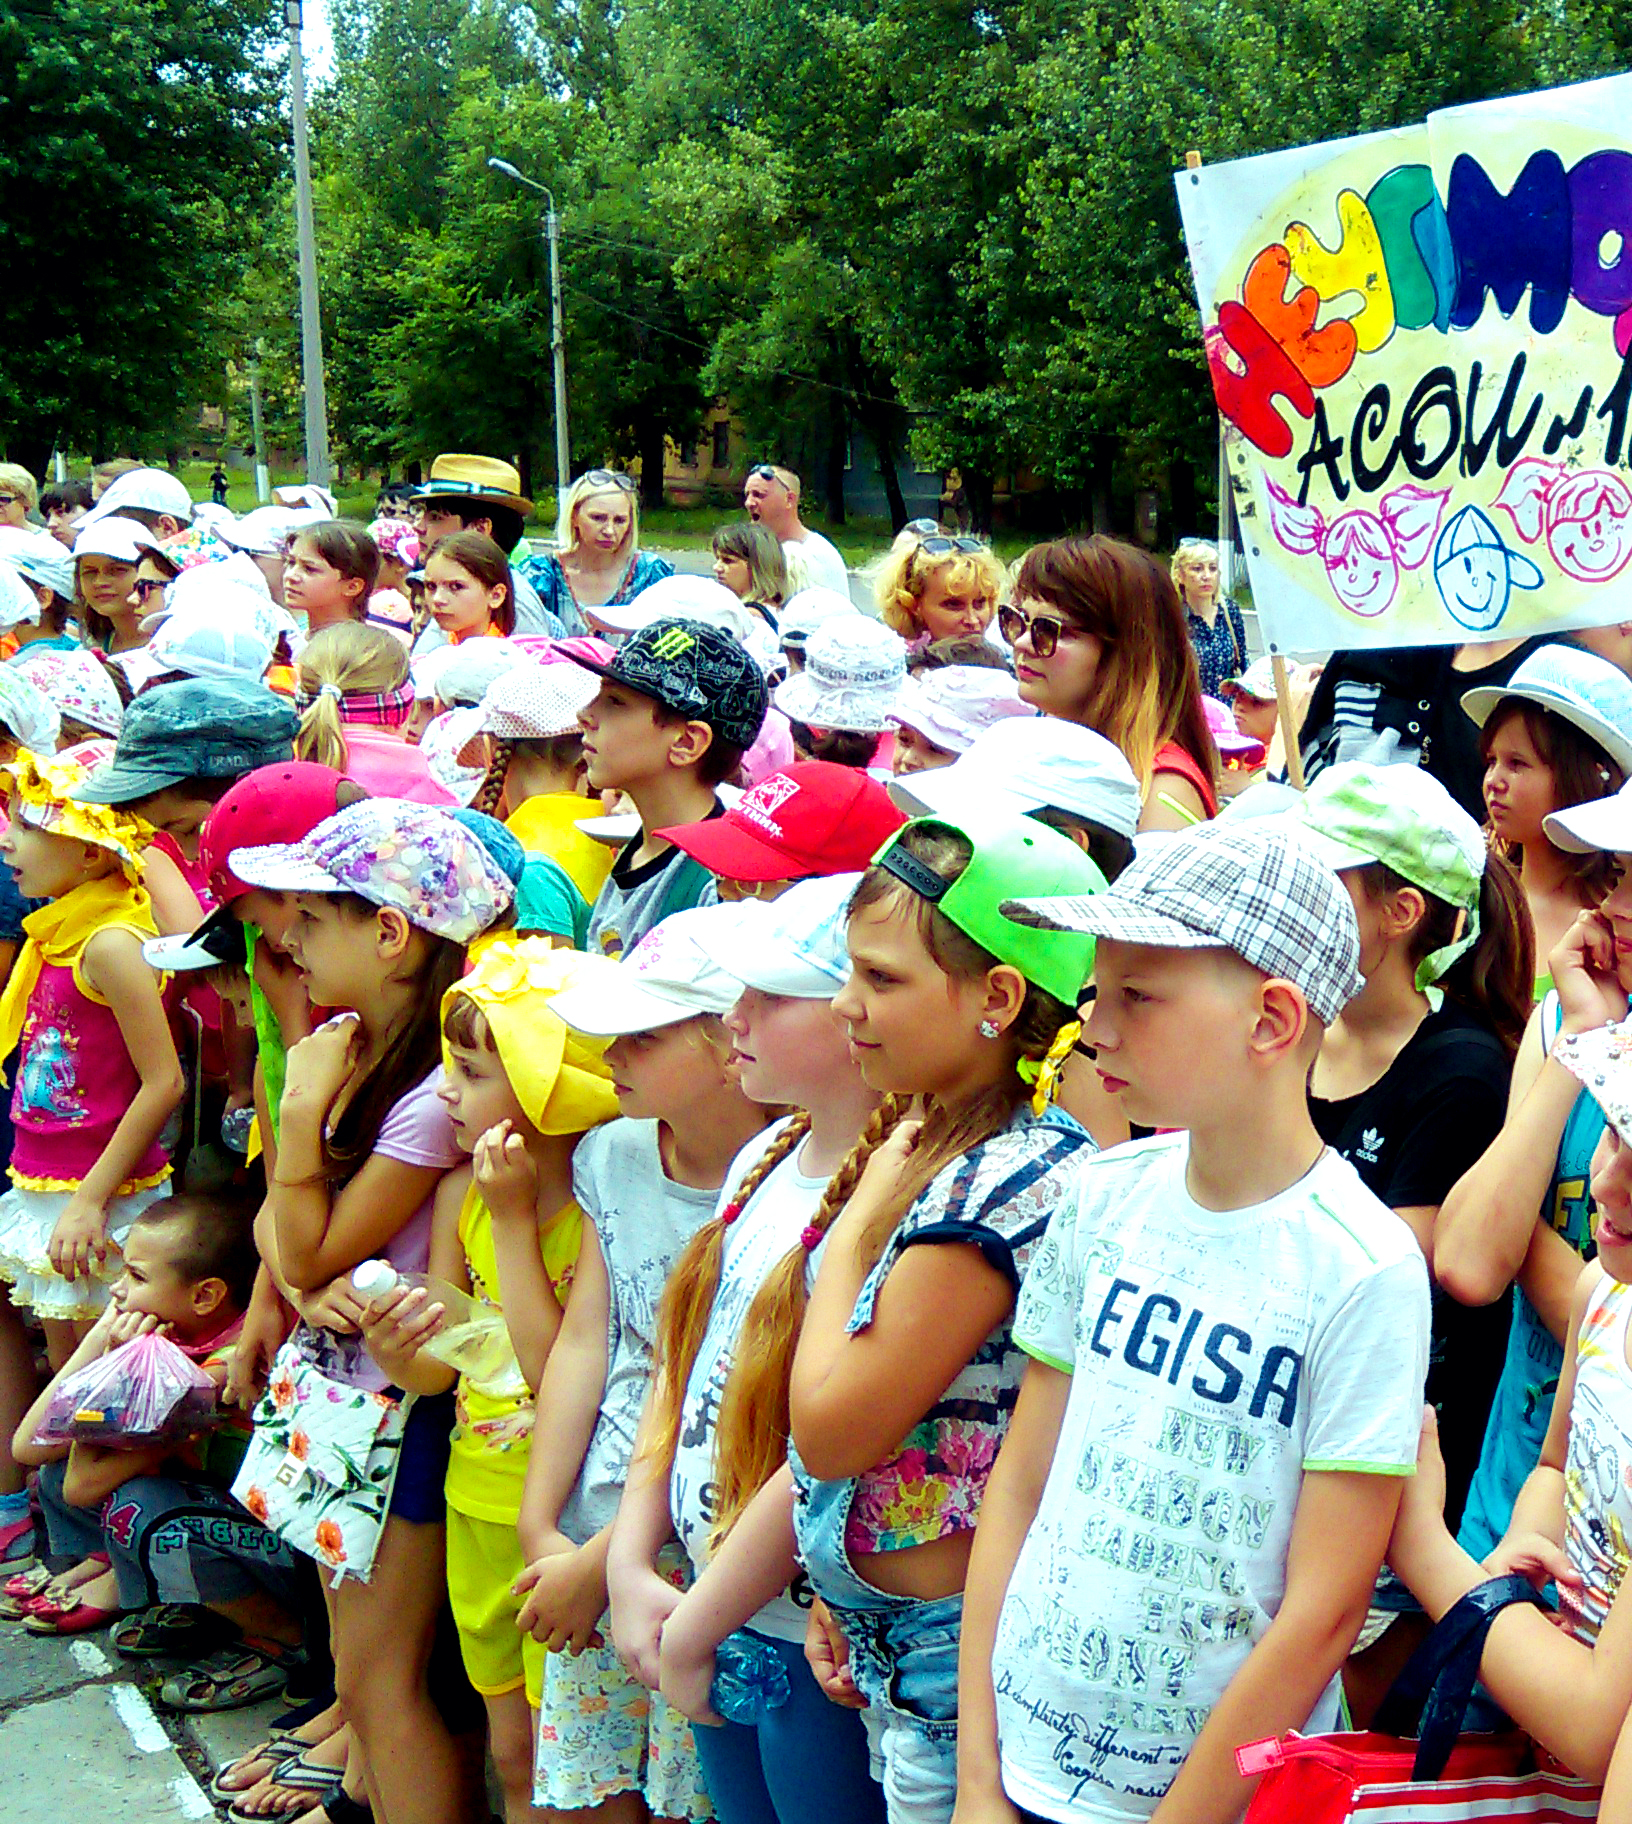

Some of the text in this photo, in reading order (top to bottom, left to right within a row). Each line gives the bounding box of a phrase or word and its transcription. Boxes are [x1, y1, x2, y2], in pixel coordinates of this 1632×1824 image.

[1089, 1276, 1303, 1429] EGISA
[1075, 1440, 1277, 1550] SEASON
[1156, 1405, 1266, 1477] NEW
